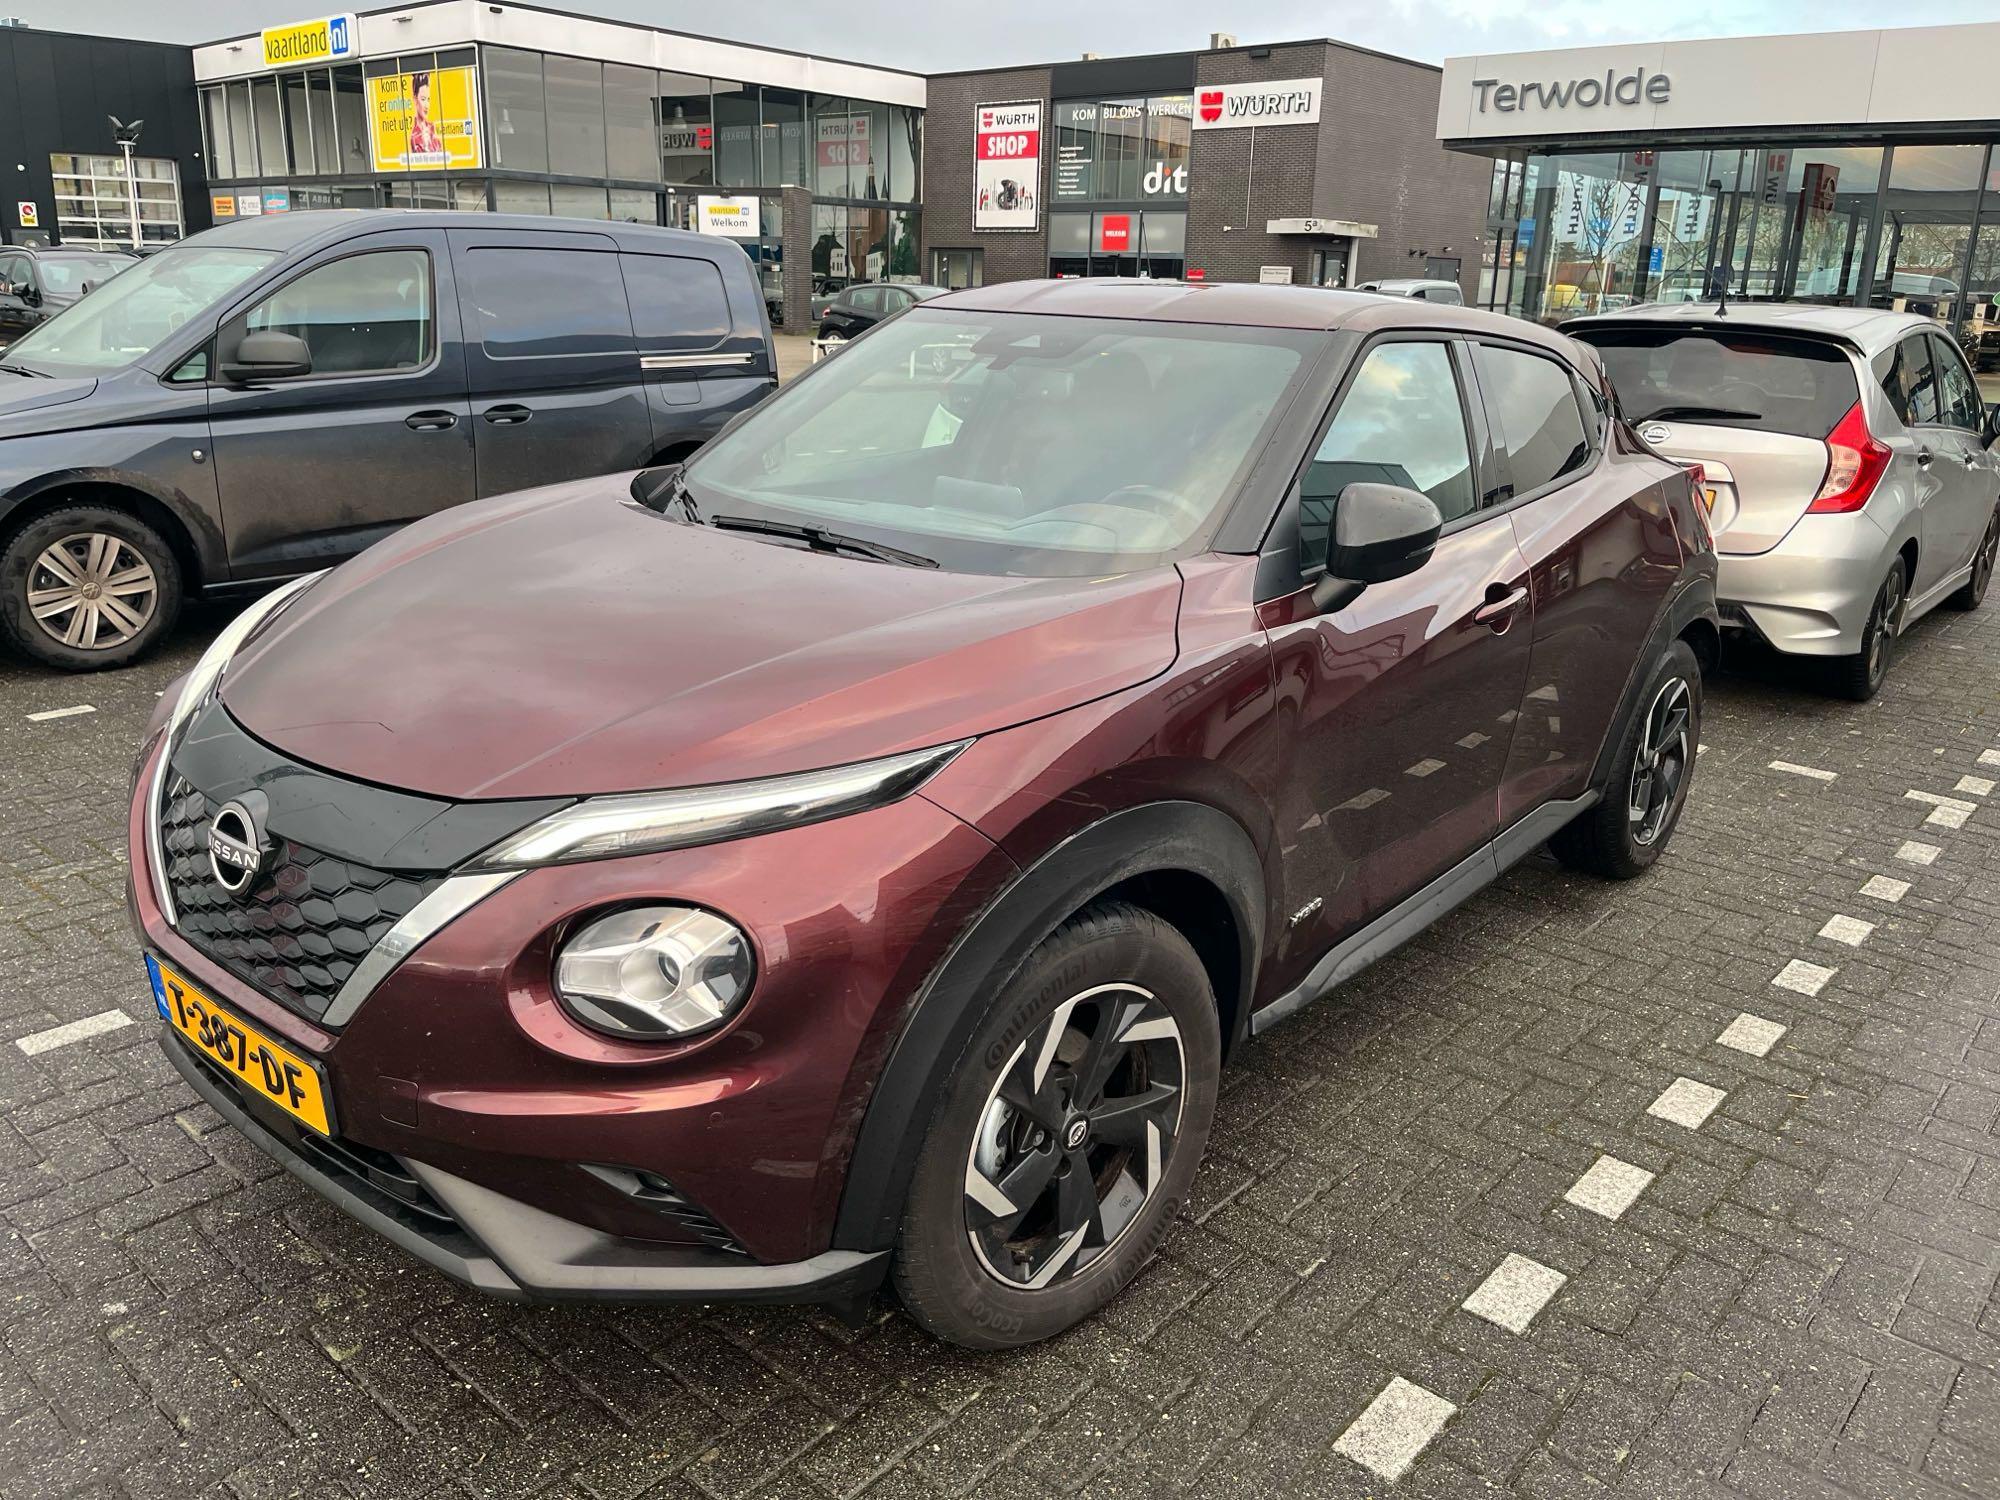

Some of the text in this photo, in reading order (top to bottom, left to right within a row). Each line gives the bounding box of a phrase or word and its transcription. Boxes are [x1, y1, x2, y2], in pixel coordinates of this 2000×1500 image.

[380, 78, 399, 93] kom
[1472, 66, 1671, 114] Terwolde
[1072, 102, 1193, 121] KOM BIJ ONS WERKEN
[1227, 91, 1312, 117] WÜRTH
[382, 116, 398, 132] niet
[995, 112, 1036, 126] WÜRTH
[987, 135, 1029, 157] SHOP
[1143, 162, 1188, 194] dit
[711, 217, 748, 227] Welkom
[208, 831, 258, 869] NISSAN
[168, 980, 306, 1109] T-387-DF
